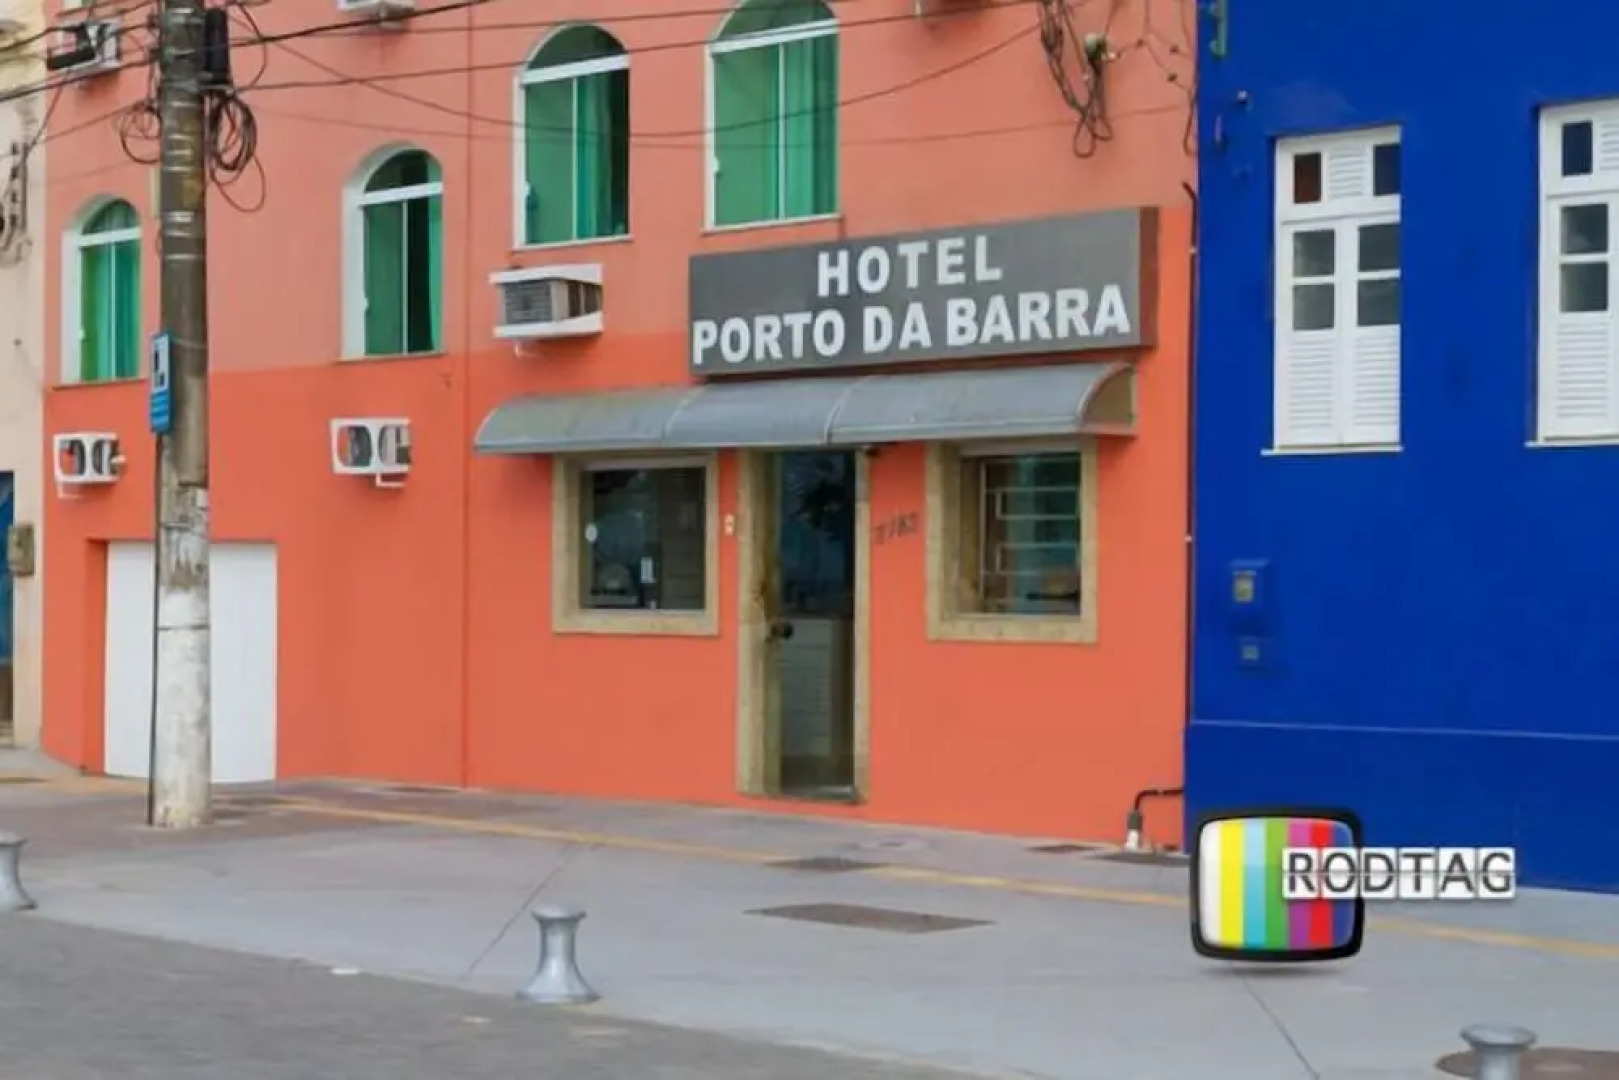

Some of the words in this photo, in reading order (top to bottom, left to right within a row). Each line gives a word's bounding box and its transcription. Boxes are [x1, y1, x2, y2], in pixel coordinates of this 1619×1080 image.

[817, 235, 1003, 298] HOTEL
[692, 309, 845, 365] PORTO
[862, 302, 932, 353] DA
[946, 284, 1132, 347] BARRA
